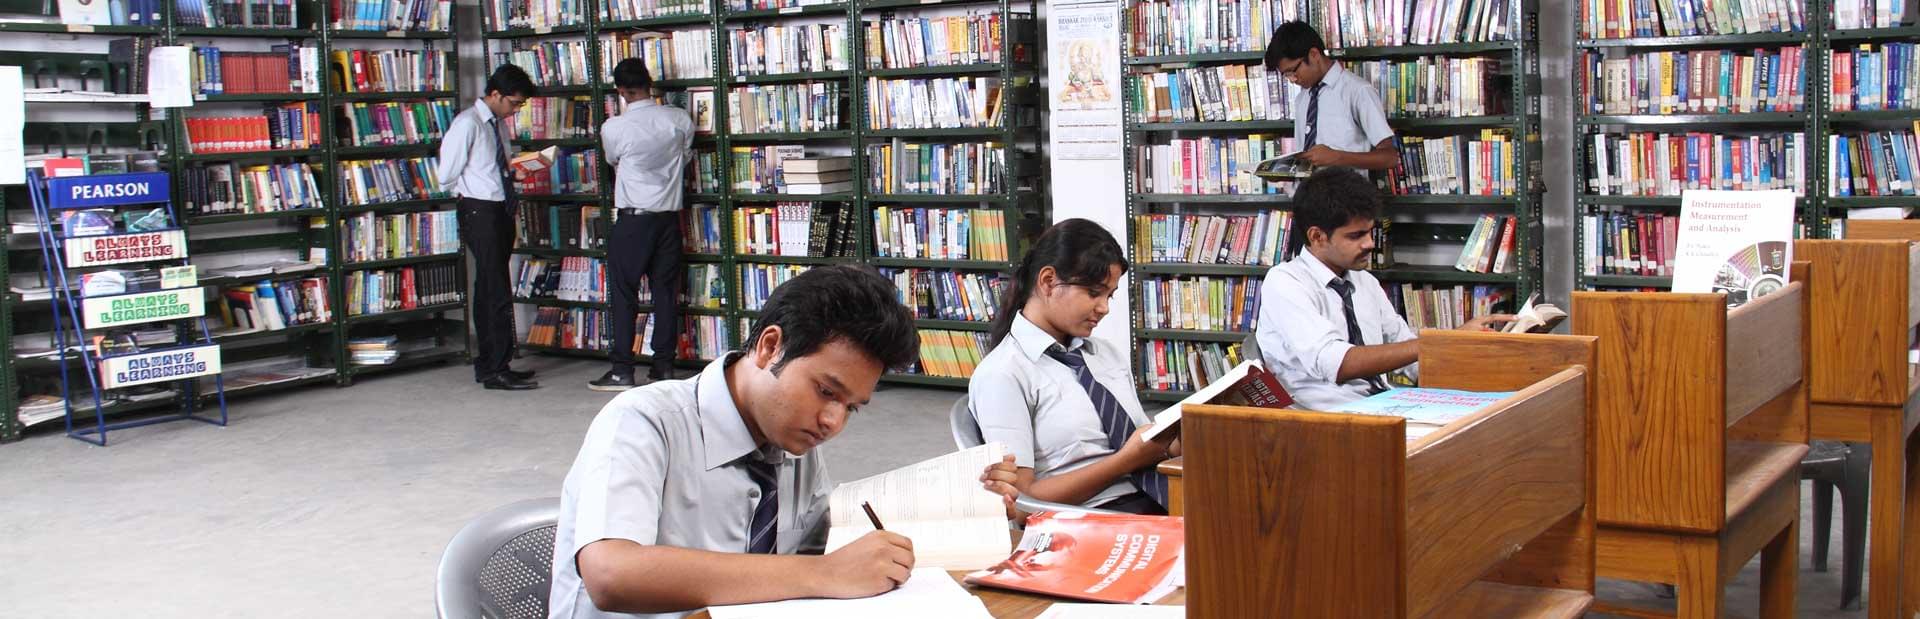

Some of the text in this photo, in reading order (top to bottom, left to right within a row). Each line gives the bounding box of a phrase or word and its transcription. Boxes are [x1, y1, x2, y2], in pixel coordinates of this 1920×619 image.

[72, 182, 149, 199] PEARSON
[1691, 200, 1762, 209] Instrumentation
[1689, 211, 1748, 220] Measurement
[1688, 224, 1741, 234] and Analysis
[95, 234, 162, 250] ALWAYS
[84, 245, 174, 262] LEARNING
[112, 293, 179, 310] ALWAYS
[101, 303, 190, 323] LEARNING
[128, 352, 195, 370] ALWAYS
[117, 361, 206, 383] LEARNING
[1095, 534, 1128, 574] SYSTEMS
[1132, 535, 1160, 571] DIGITAL
